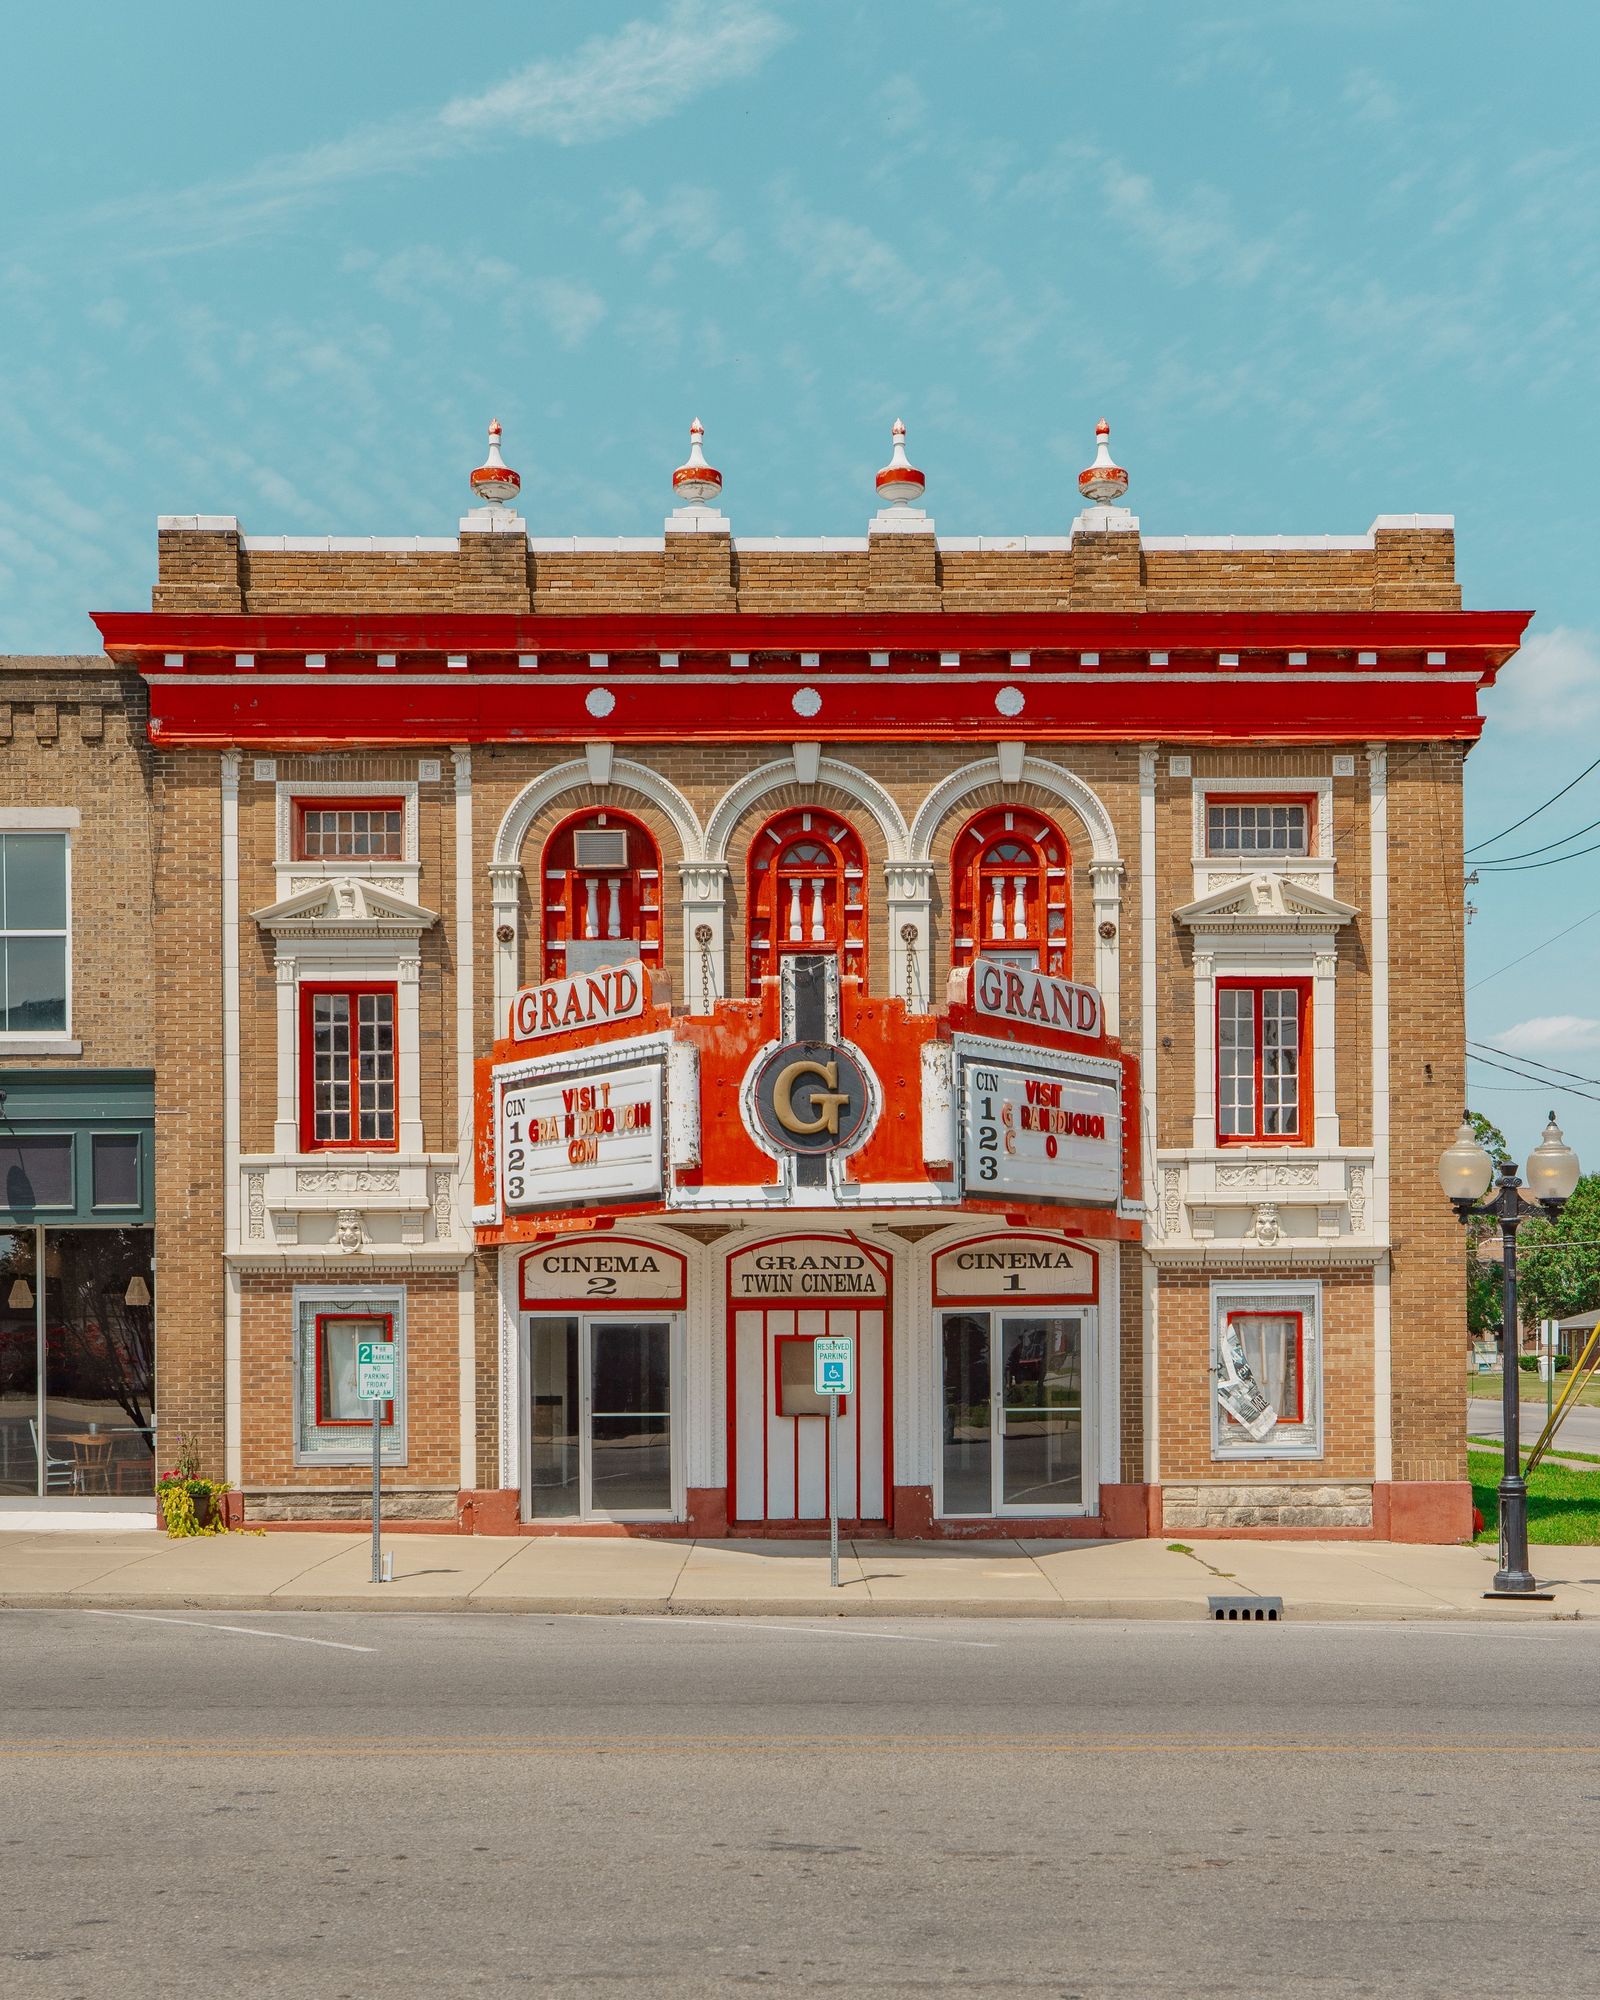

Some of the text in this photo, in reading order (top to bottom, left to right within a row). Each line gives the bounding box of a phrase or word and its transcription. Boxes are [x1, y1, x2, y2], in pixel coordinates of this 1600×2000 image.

[517, 969, 639, 1035] GRAND
[979, 965, 1097, 1031] GRAND
[976, 1071, 998, 1092] CIN
[773, 1060, 849, 1134] G
[1024, 1079, 1063, 1109] VISIT
[505, 1098, 526, 1118] CIN
[980, 1097, 996, 1121] 1
[509, 1121, 524, 1144] 1
[979, 1126, 998, 1151] 2
[508, 1149, 525, 1172] 2
[567, 1137, 599, 1164] COM
[979, 1156, 998, 1181] 3
[508, 1176, 525, 1199] 3
[542, 1256, 660, 1273] CINEMA
[754, 1255, 866, 1271] GRAND
[956, 1252, 1074, 1270] CINEMA
[586, 1276, 617, 1295] 2
[741, 1273, 876, 1293] TWIN CINEMA
[1002, 1273, 1027, 1291] 1
[361, 1345, 370, 1361] 2
